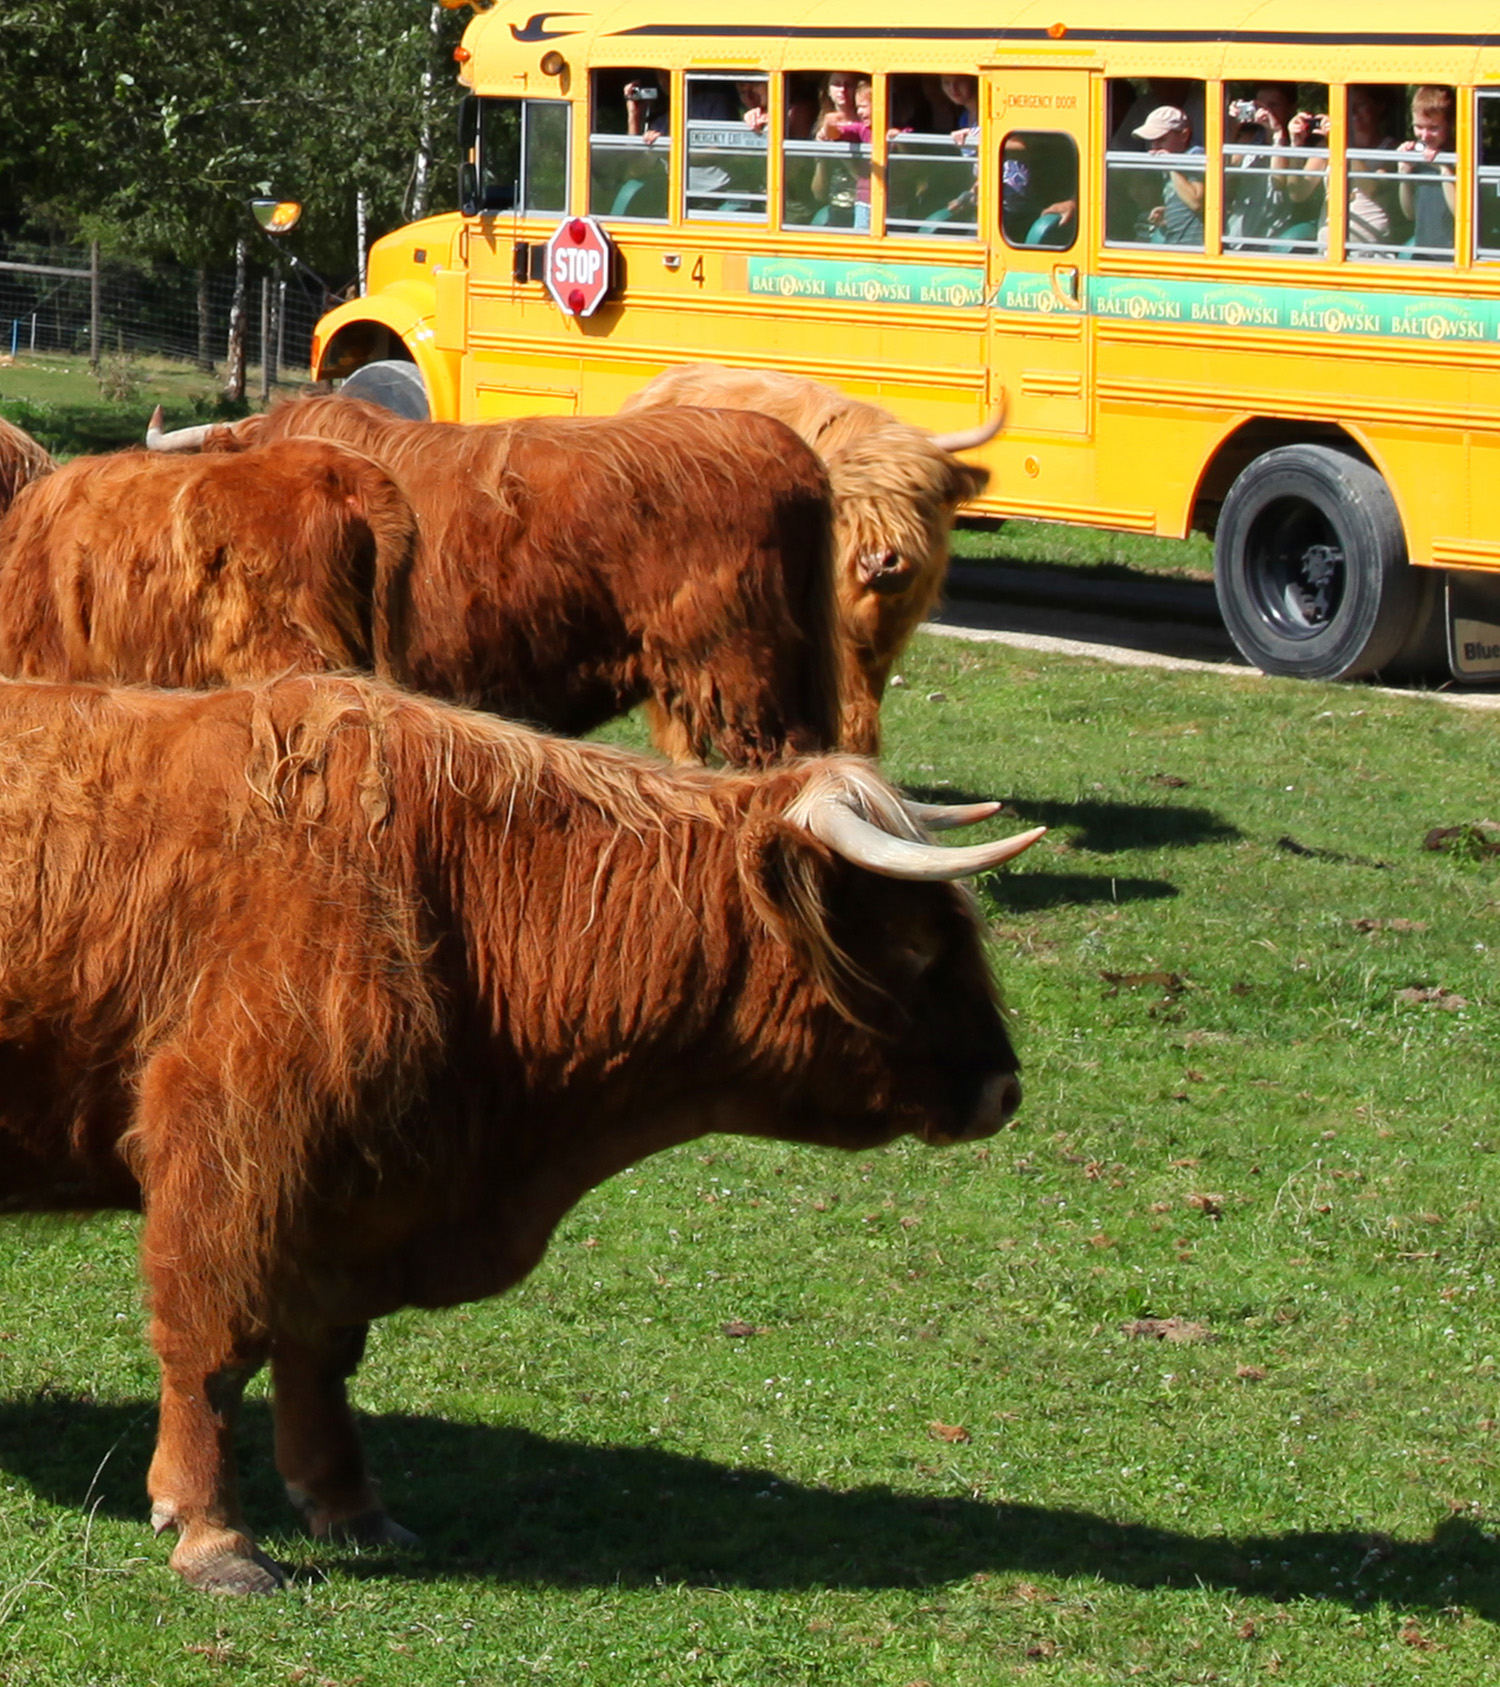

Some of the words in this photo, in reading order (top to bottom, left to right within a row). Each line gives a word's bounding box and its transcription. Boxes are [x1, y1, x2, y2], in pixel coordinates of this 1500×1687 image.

[554, 247, 600, 285] STOP
[691, 254, 705, 289] 4
[1097, 295, 1181, 319] BAŁTOWSKI
[1191, 301, 1278, 326] BAŁTOWSKI
[1290, 308, 1380, 333] BAŁTOWSKI
[1391, 314, 1484, 340] BAŁTOWSKI
